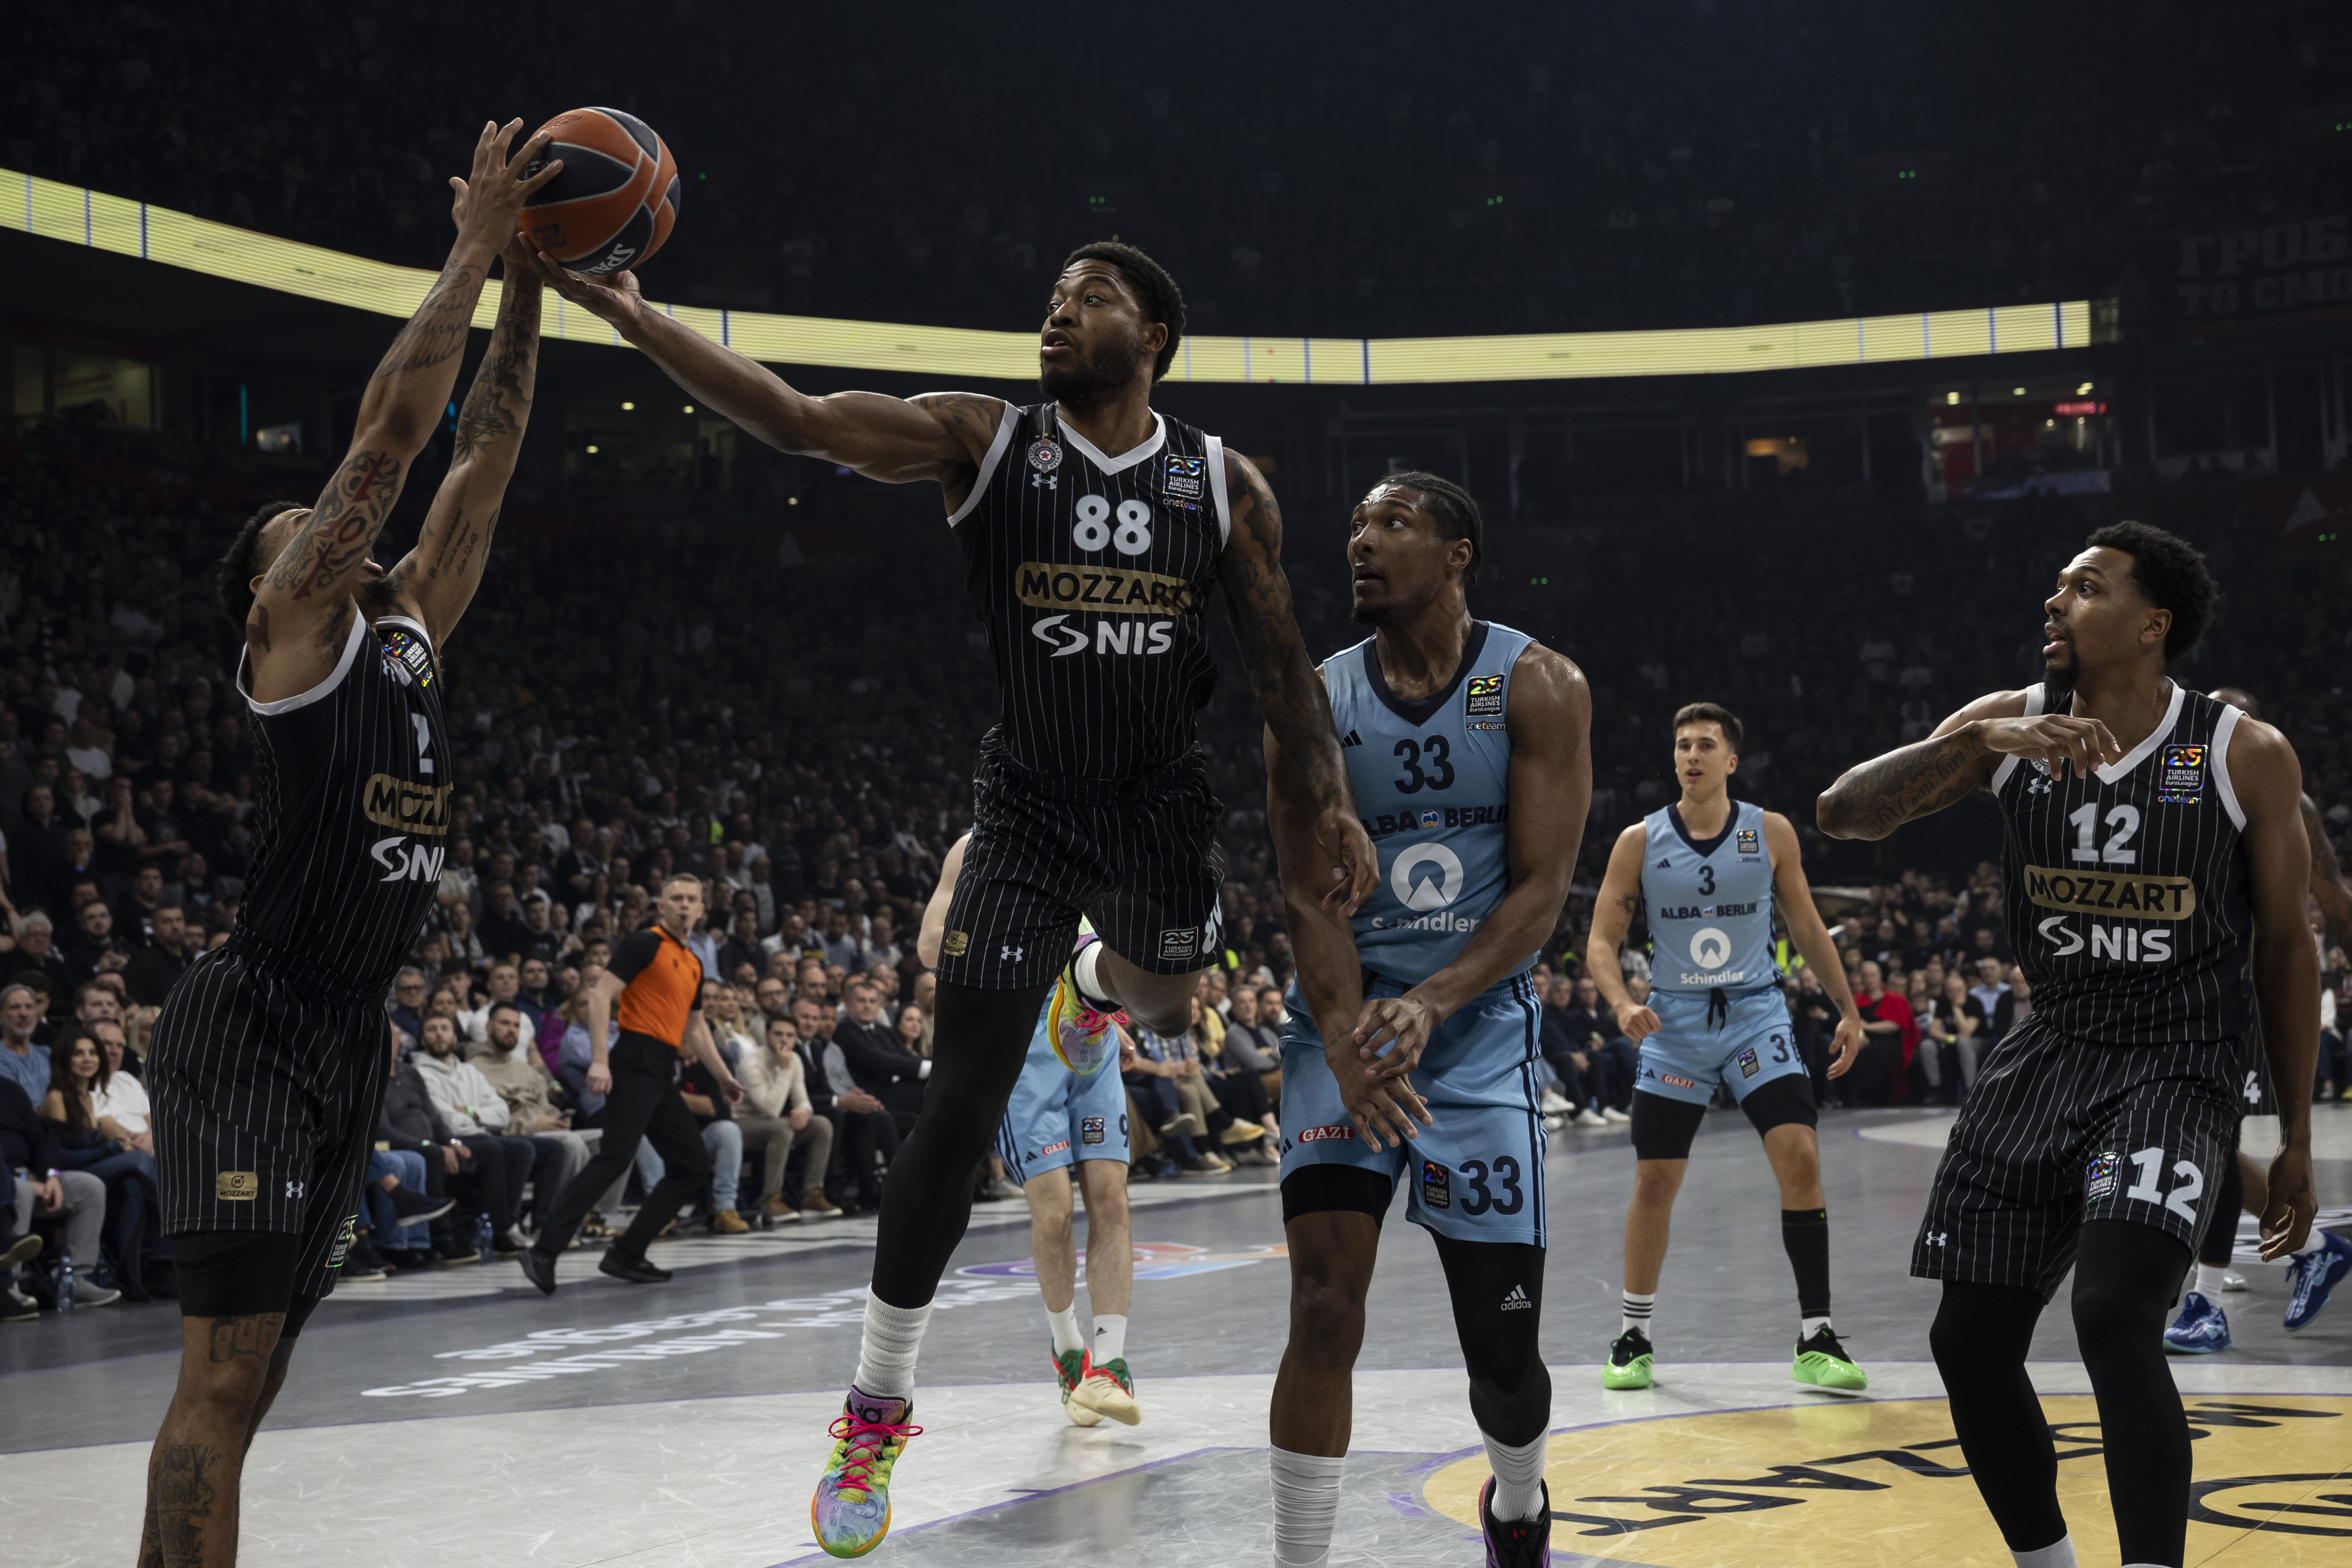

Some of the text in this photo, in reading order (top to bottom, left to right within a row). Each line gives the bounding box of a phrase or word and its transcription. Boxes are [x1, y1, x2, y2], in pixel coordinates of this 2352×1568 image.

[583, 243, 635, 274] SPAL
[1169, 458, 1201, 476] 25
[1169, 476, 1199, 485] TURKISH
[1169, 481, 1199, 490] AIRLINES
[1168, 485, 1199, 495] EuroLeague
[1163, 498, 1203, 512] oneteam
[1073, 494, 1151, 556] 88
[1022, 569, 1190, 608] MOZZART
[1097, 621, 1173, 654] NIS
[402, 642, 420, 659] TURKISH
[408, 646, 425, 664] AIRLINES
[1470, 677, 1502, 695] 25
[1466, 721, 1506, 730] oneteam
[1393, 735, 1455, 795] 33
[2167, 748, 2202, 766] 25
[2158, 794, 2202, 804] oneteam
[1361, 811, 1419, 836] LBA
[2069, 802, 2140, 864] 12
[410, 844, 445, 882] NI
[1698, 865, 1716, 895] 3
[2029, 871, 2189, 912] MOZZART
[1661, 902, 1757, 918] ALBA BERLIN
[1165, 931, 1194, 944] 25
[2092, 924, 2171, 962] NIS
[1681, 970, 1744, 984] Schindler
[1770, 1034, 1789, 1063] 3
[1459, 1156, 1523, 1215] 33
[2089, 1181, 2111, 1192] AIRLINES
[2091, 1175, 2112, 1185] TURKISH
[2127, 1146, 2205, 1226] 12
[1426, 1185, 1446, 1195] TURKISH
[1426, 1191, 1447, 1200] AIRLINES
[1501, 1298, 1532, 1311] adidas
